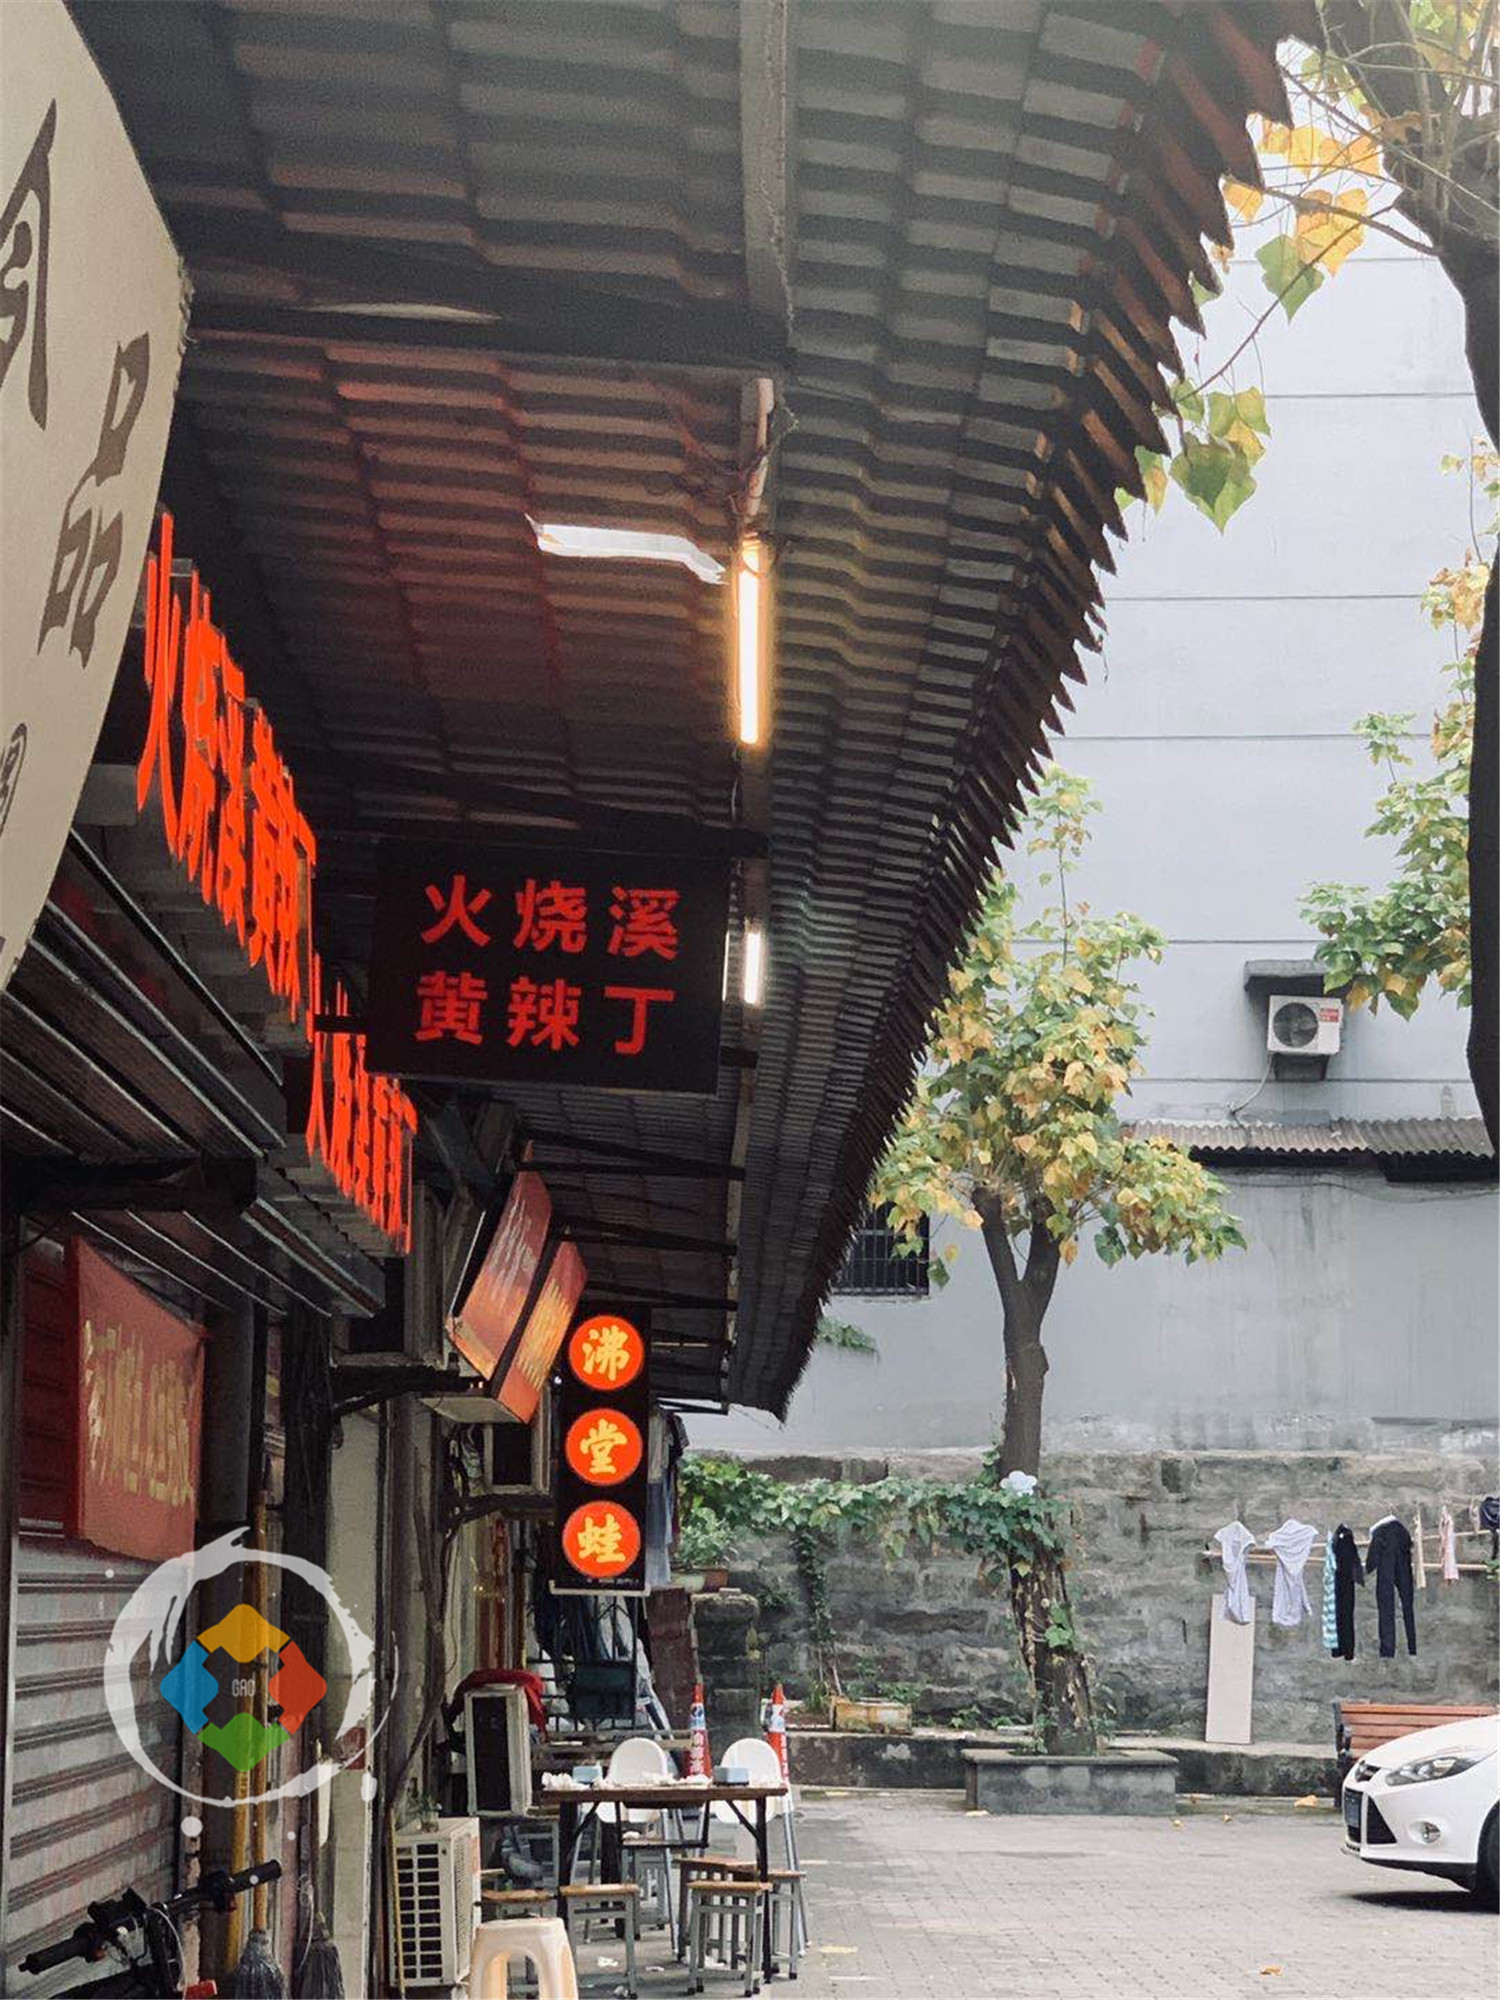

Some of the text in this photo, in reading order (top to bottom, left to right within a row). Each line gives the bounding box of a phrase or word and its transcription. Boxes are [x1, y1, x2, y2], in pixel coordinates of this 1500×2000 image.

[421, 874, 681, 961] 火烧溪
[415, 970, 676, 1055] 黄辣丁
[577, 1323, 631, 1564] 沸堂蛙
